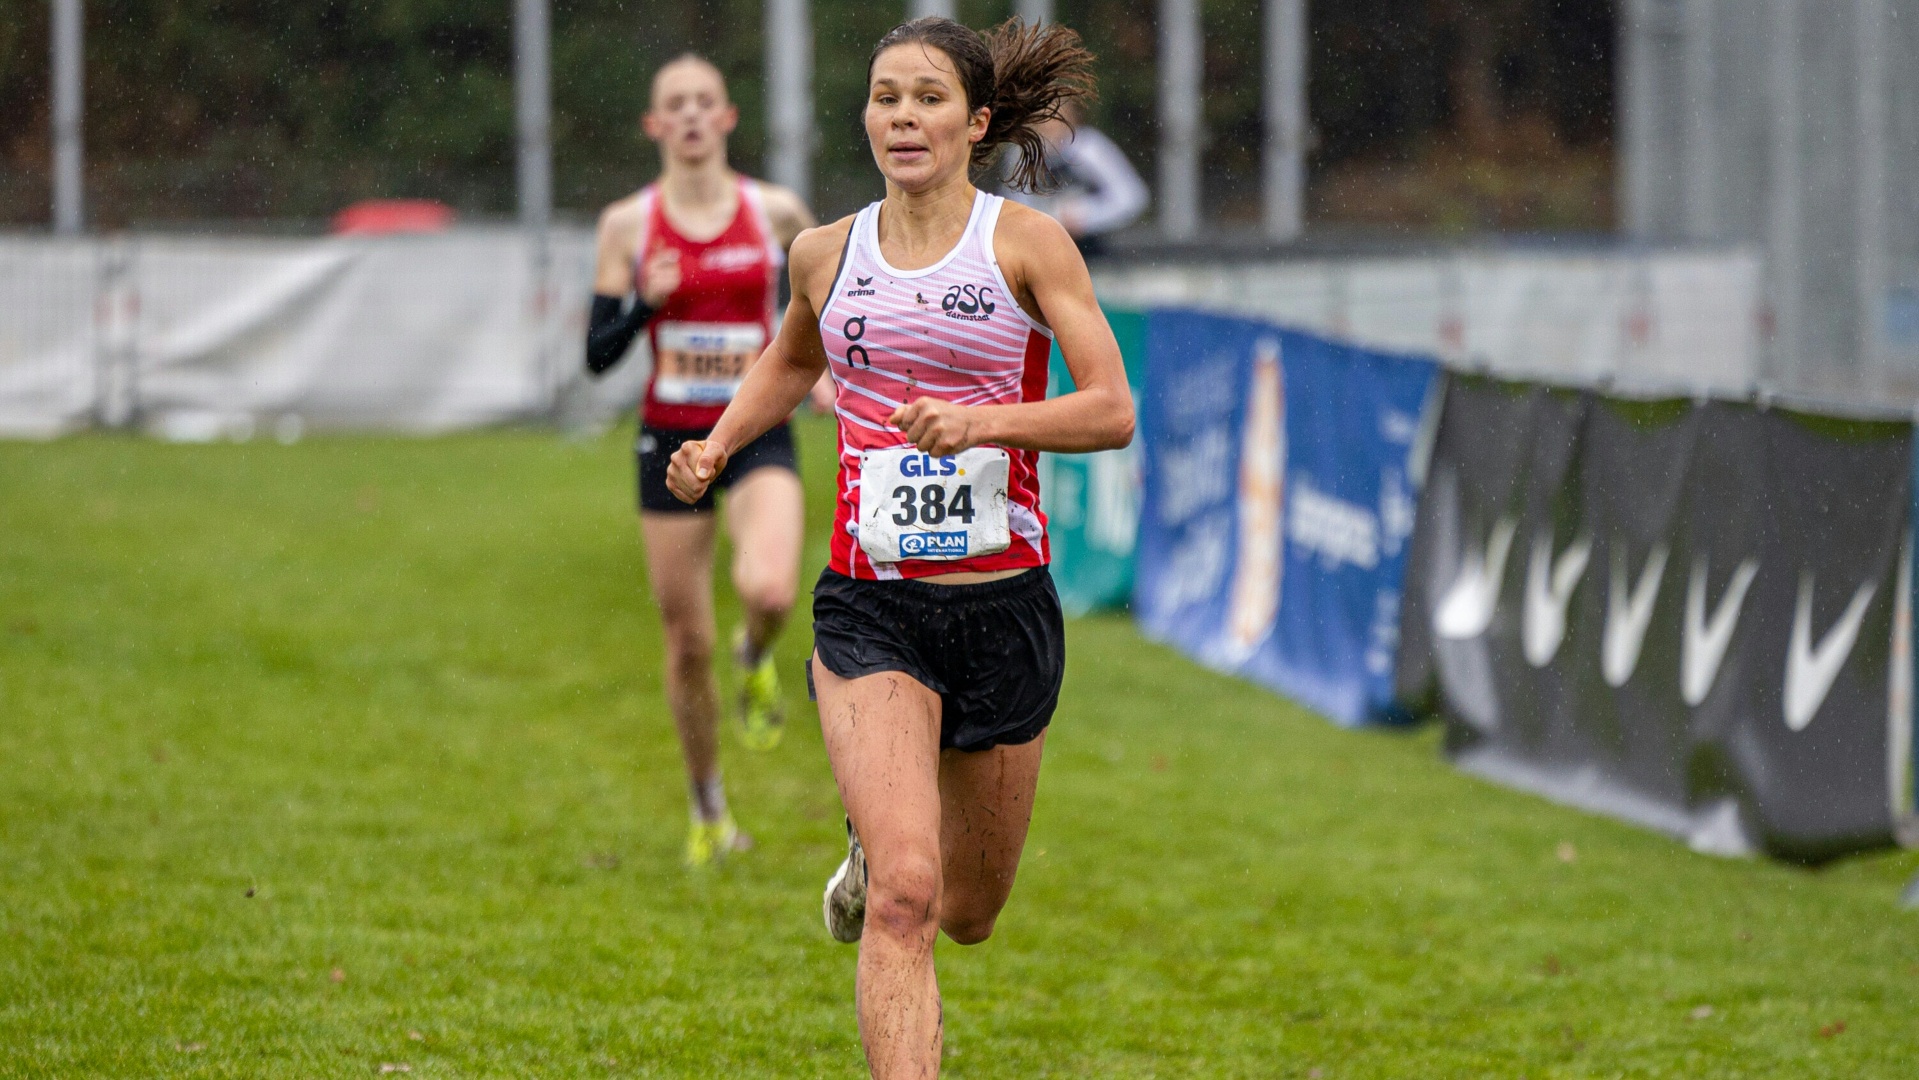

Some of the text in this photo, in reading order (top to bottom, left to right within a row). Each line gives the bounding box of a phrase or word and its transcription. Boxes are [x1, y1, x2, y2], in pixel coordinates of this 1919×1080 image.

[847, 288, 876, 297] erima
[891, 483, 976, 527] 384
[927, 535, 965, 548] PLAN
